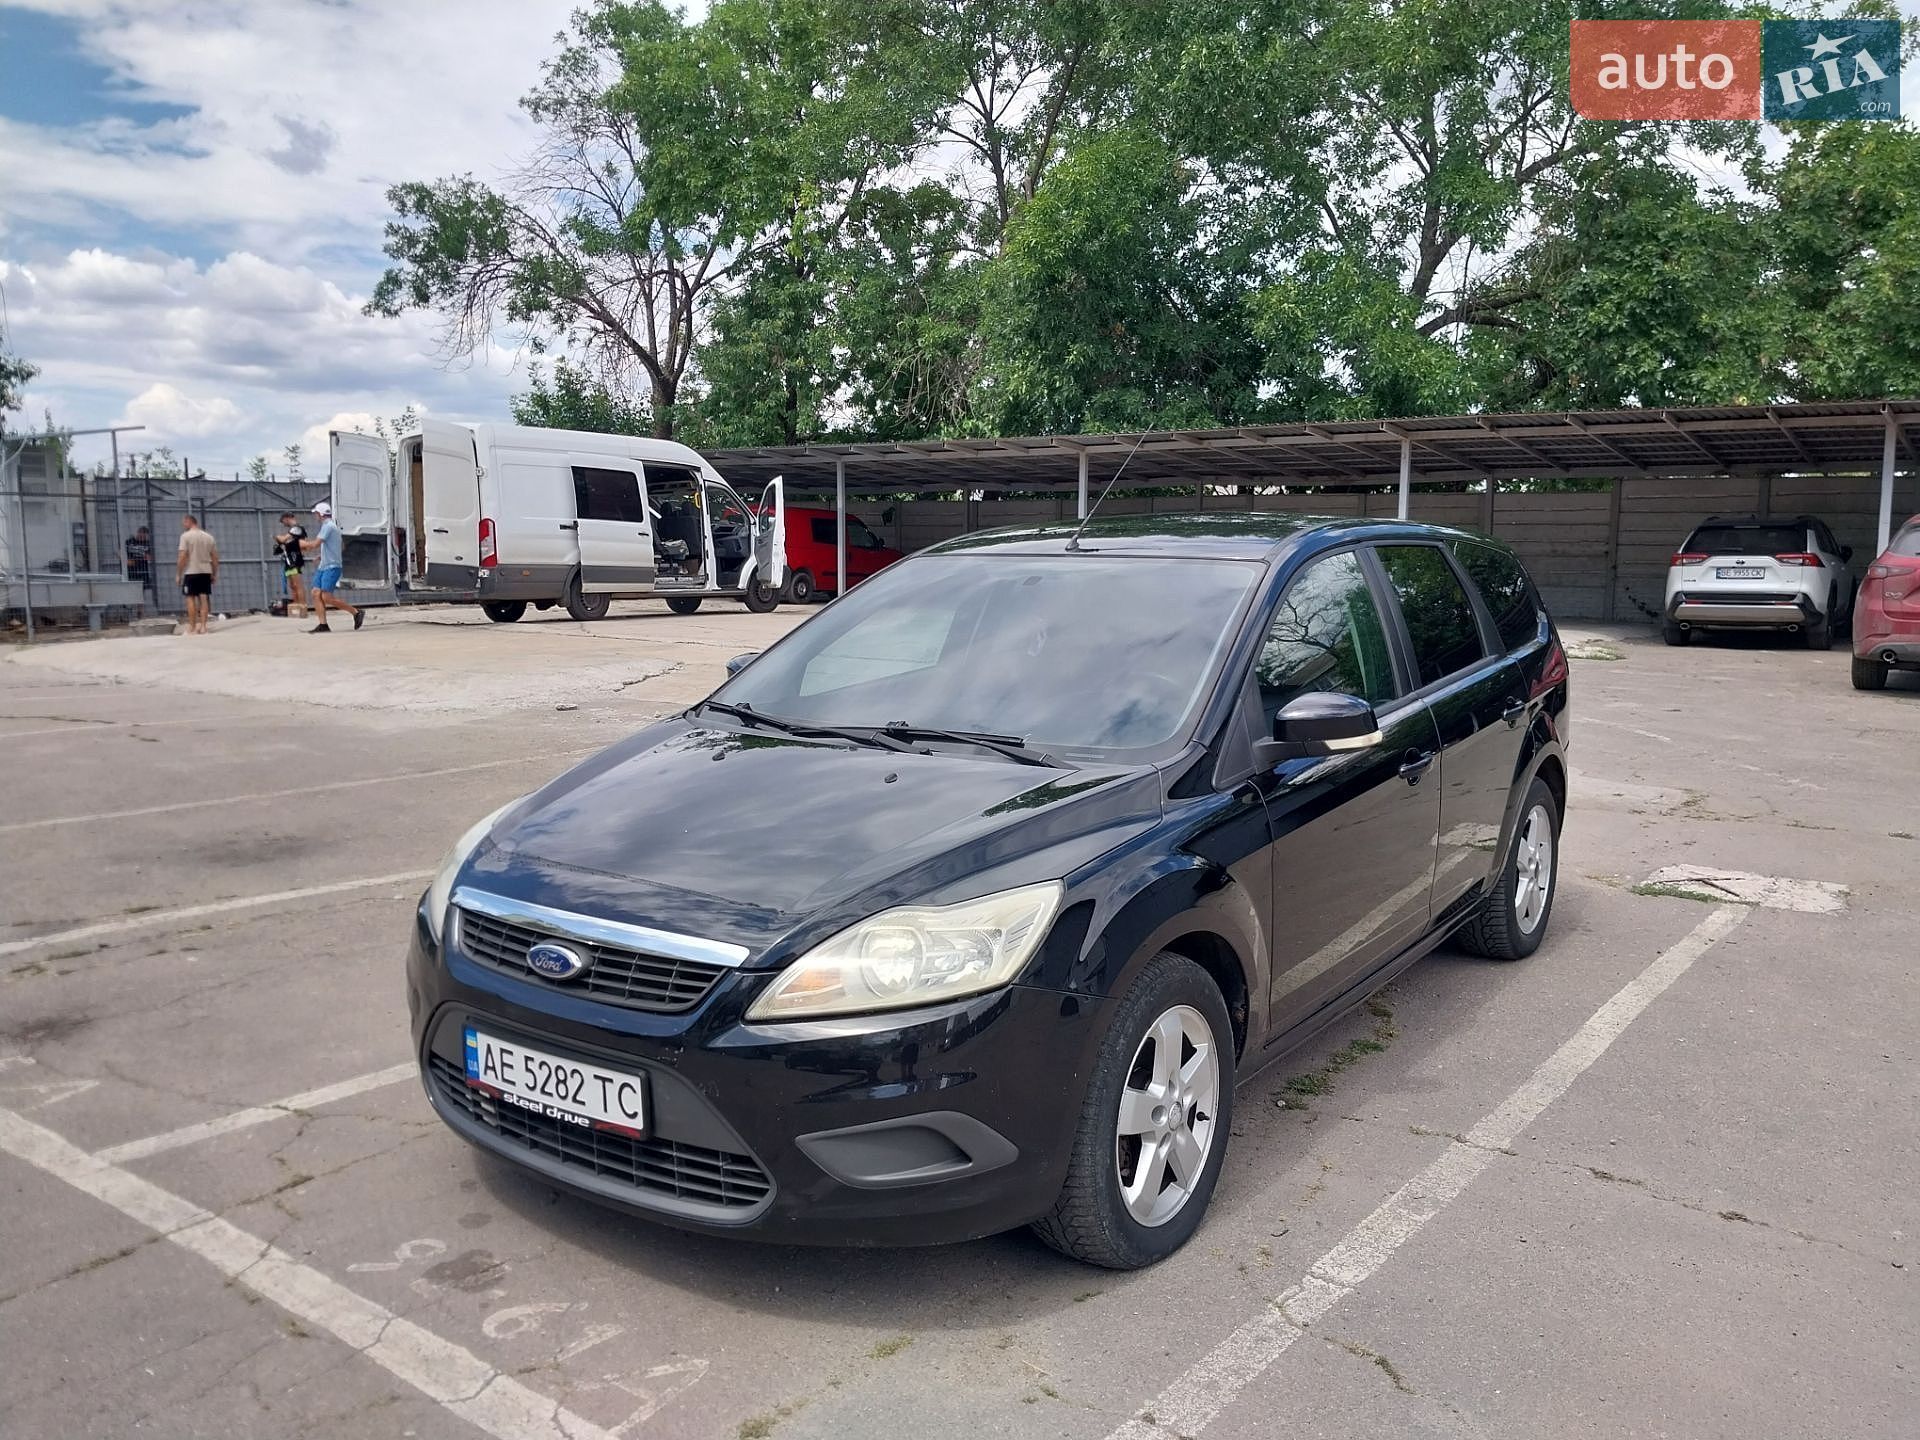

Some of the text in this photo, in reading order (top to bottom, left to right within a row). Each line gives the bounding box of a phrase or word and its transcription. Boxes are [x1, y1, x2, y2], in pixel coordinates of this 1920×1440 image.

[535, 950, 564, 971] Ford
[467, 1059, 479, 1072] UA
[483, 1043, 639, 1119] AE 5282 TC
[503, 1093, 590, 1127] steel drive
